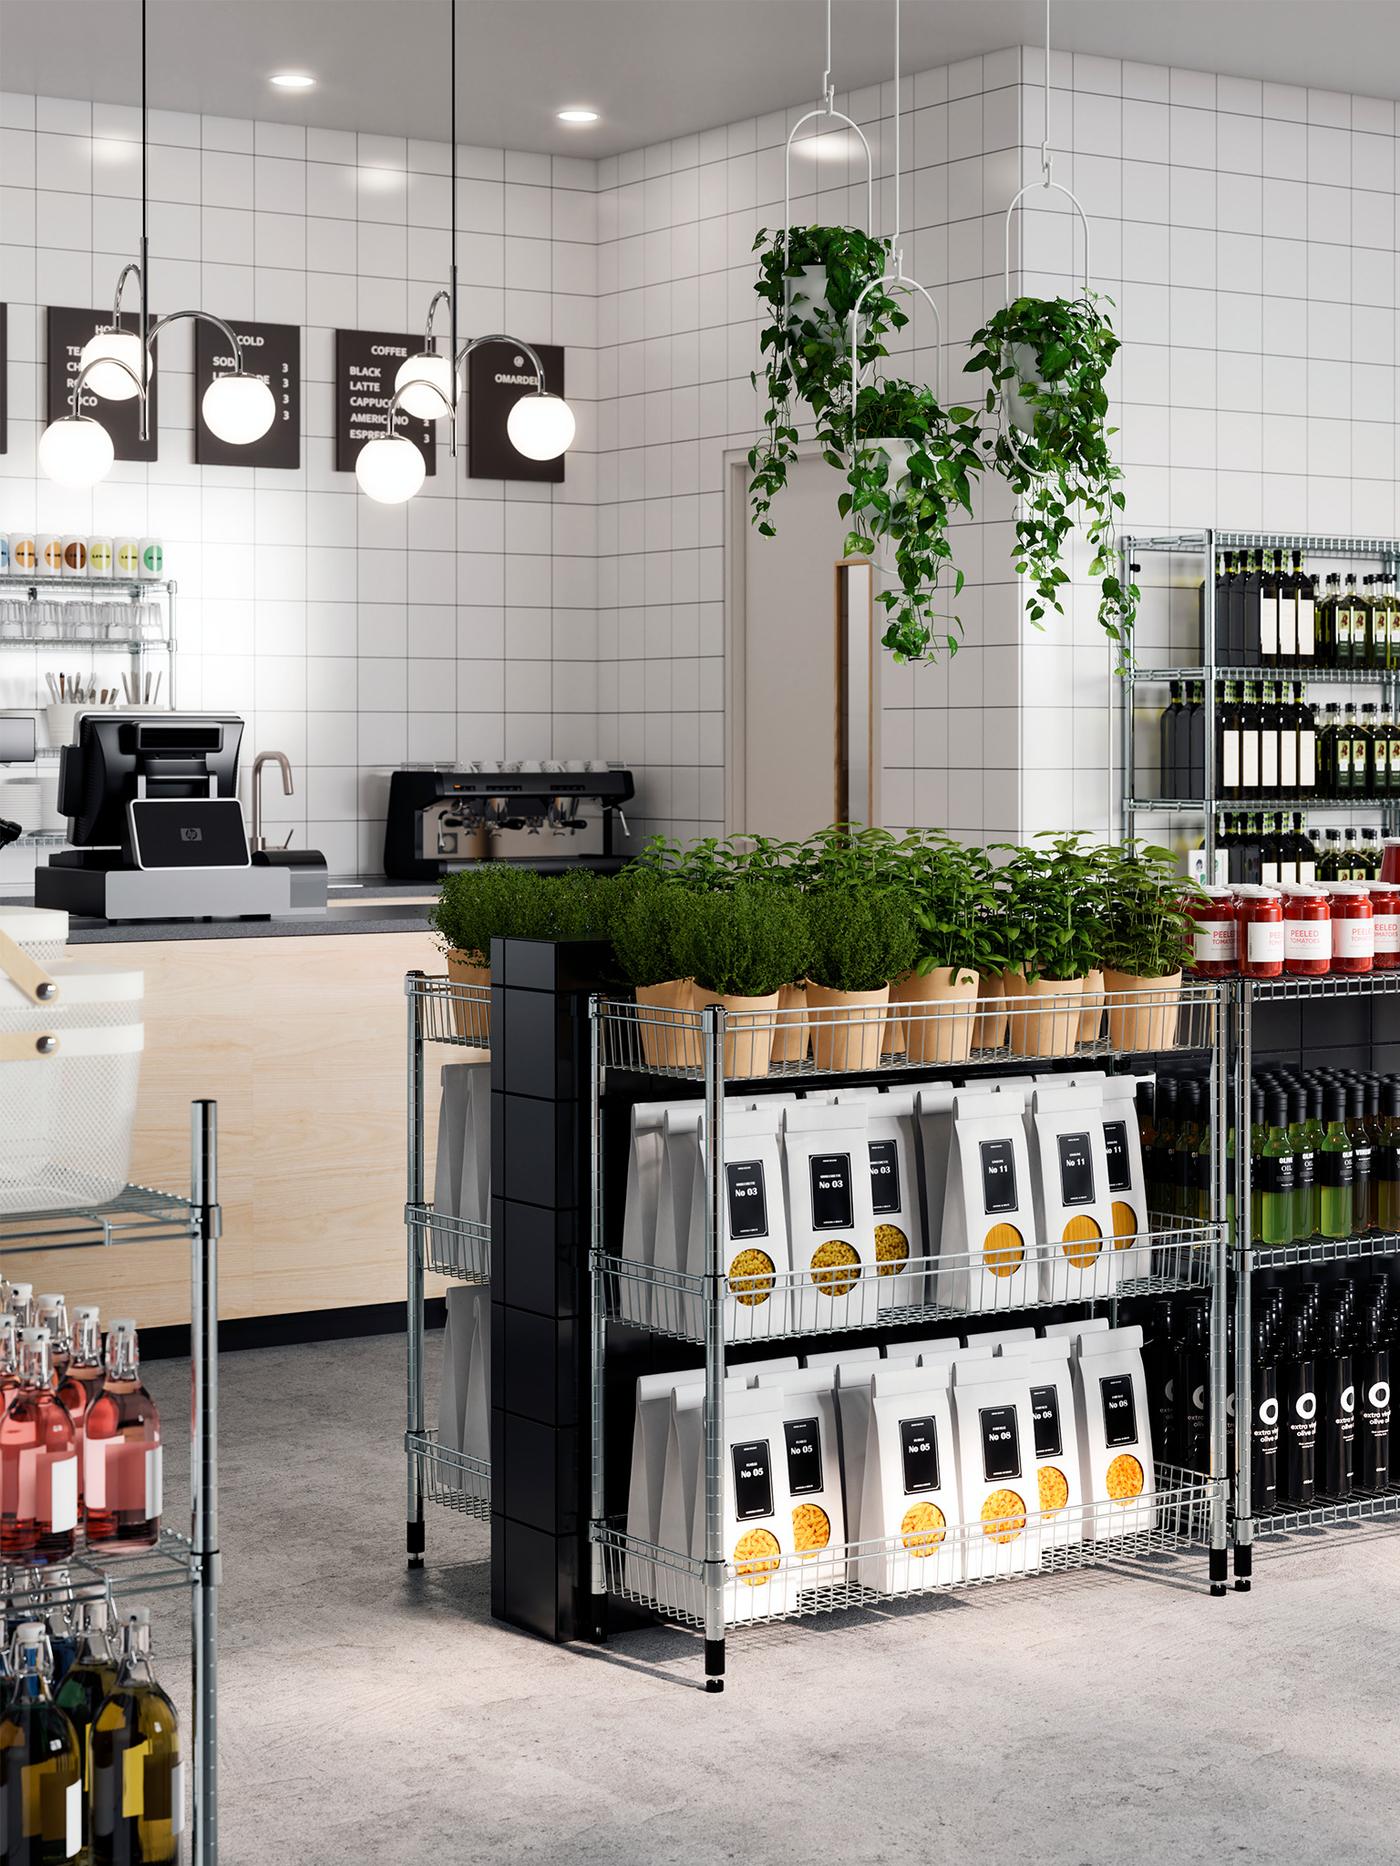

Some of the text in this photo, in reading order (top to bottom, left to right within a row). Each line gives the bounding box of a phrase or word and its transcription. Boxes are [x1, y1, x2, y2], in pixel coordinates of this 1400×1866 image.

[237, 335, 265, 346] COLD
[371, 345, 408, 357] COFFEE
[212, 356, 289, 373] SOD 3
[349, 366, 381, 378] BLACK
[282, 378, 289, 388] 3
[349, 381, 381, 392] LATTE
[282, 394, 290, 404] 3
[282, 410, 290, 421] 3
[350, 413, 409, 426] AMERICNO
[423, 434, 430, 444] 3
[1374, 923, 1398, 931] EELED
[1290, 929, 1319, 938] PEELED
[1077, 1158, 1085, 1166] 11
[880, 1166, 891, 1174] 03
[989, 1165, 1008, 1174] No 11
[819, 1180, 843, 1189] No 03
[735, 1187, 758, 1197] No 03
[1119, 1400, 1128, 1408] 08
[1043, 1411, 1053, 1419] 08
[1001, 1432, 1011, 1440] 08
[802, 1445, 813, 1453] 05
[920, 1443, 931, 1452] 05
[741, 1467, 764, 1478] No 05
